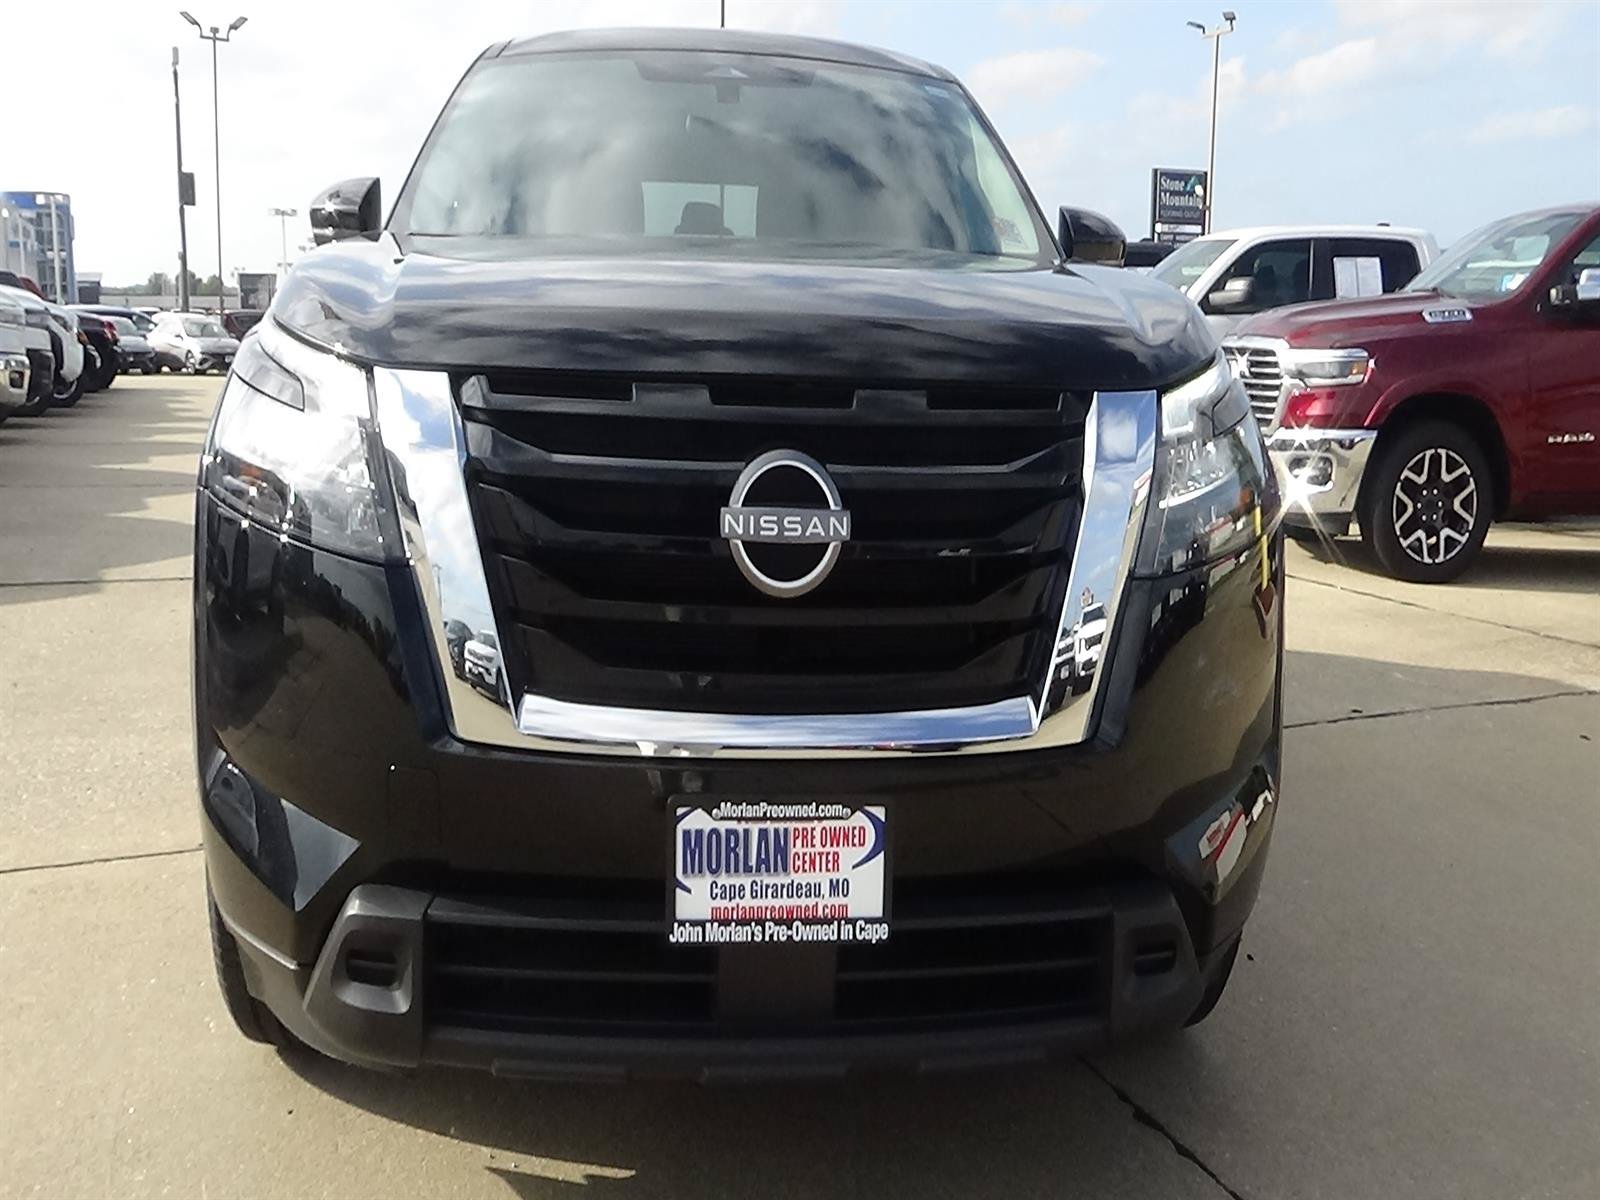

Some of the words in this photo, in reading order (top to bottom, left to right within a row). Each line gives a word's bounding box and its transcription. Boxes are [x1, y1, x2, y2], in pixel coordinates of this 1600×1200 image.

[1161, 176, 1185, 191] Stone
[724, 513, 848, 537] NISSAN
[720, 801, 843, 818] MorlanPreowned.com
[792, 826, 816, 848] PRE
[820, 825, 867, 848] OWNED
[682, 827, 790, 875] MORLAN
[792, 851, 841, 874] CENTER
[710, 880, 746, 902] Cape
[750, 879, 825, 900] Girardeau,
[829, 878, 850, 898] MO
[711, 902, 849, 920] morlanpreowned.com
[669, 922, 703, 943] John
[705, 922, 763, 943] Morlan's
[764, 920, 838, 942] Pre-Owned
[840, 920, 853, 941] in
[855, 920, 889, 944] Cape
